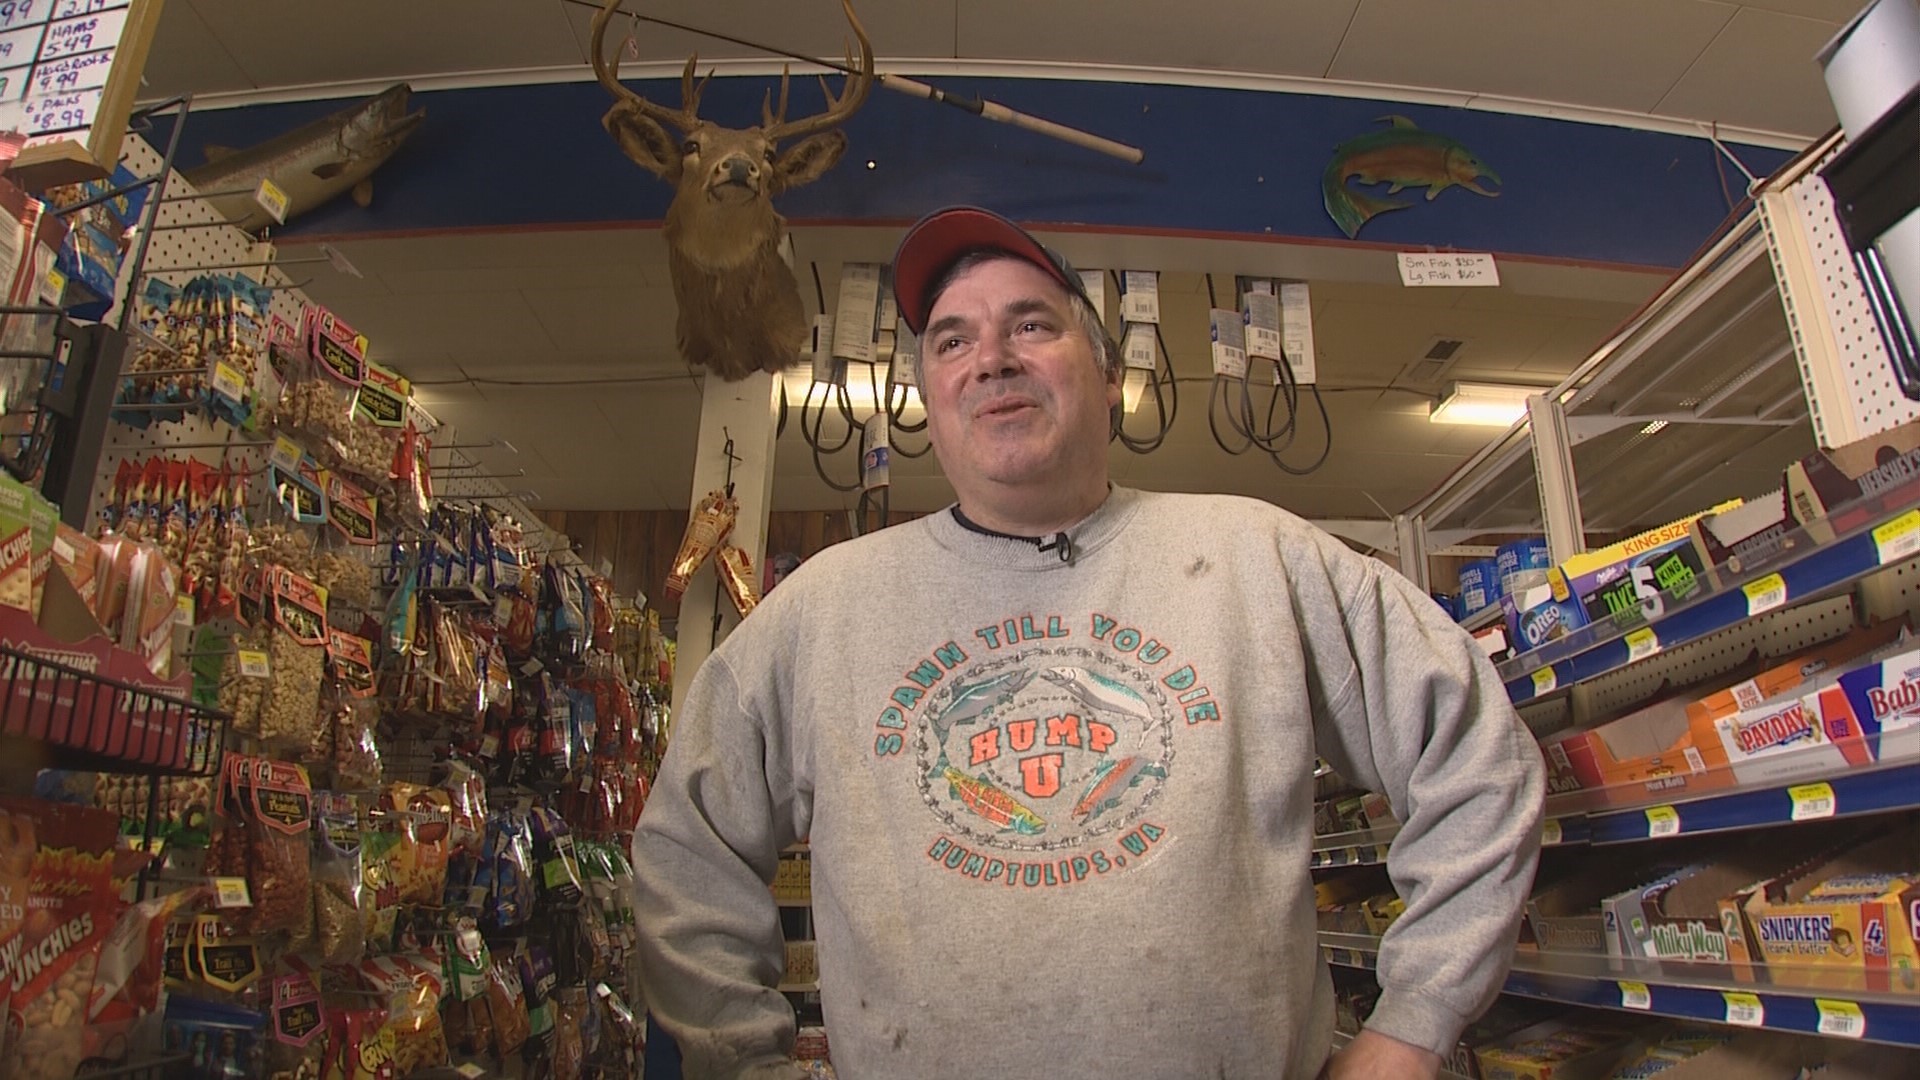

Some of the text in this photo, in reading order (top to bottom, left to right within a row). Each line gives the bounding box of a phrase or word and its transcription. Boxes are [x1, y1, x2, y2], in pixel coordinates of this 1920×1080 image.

[1405, 257, 1425, 268] Sm
[1429, 258, 1451, 268] Fish
[1409, 270, 1424, 284] Lg
[1428, 270, 1451, 280] Fish
[1623, 533, 1661, 556] KING
[1658, 559, 1682, 584] KING
[1630, 565, 1664, 621] 5
[1526, 605, 1561, 645] OREO
[874, 612, 1221, 757] SPAWN TILL YOU DIE
[969, 713, 1118, 767] HUMP
[1740, 703, 1809, 754] PAYDAY
[1019, 752, 1064, 798] U
[1722, 906, 1741, 938] 2
[1760, 915, 1833, 942] SNICKERS
[1864, 918, 1884, 947] 4
